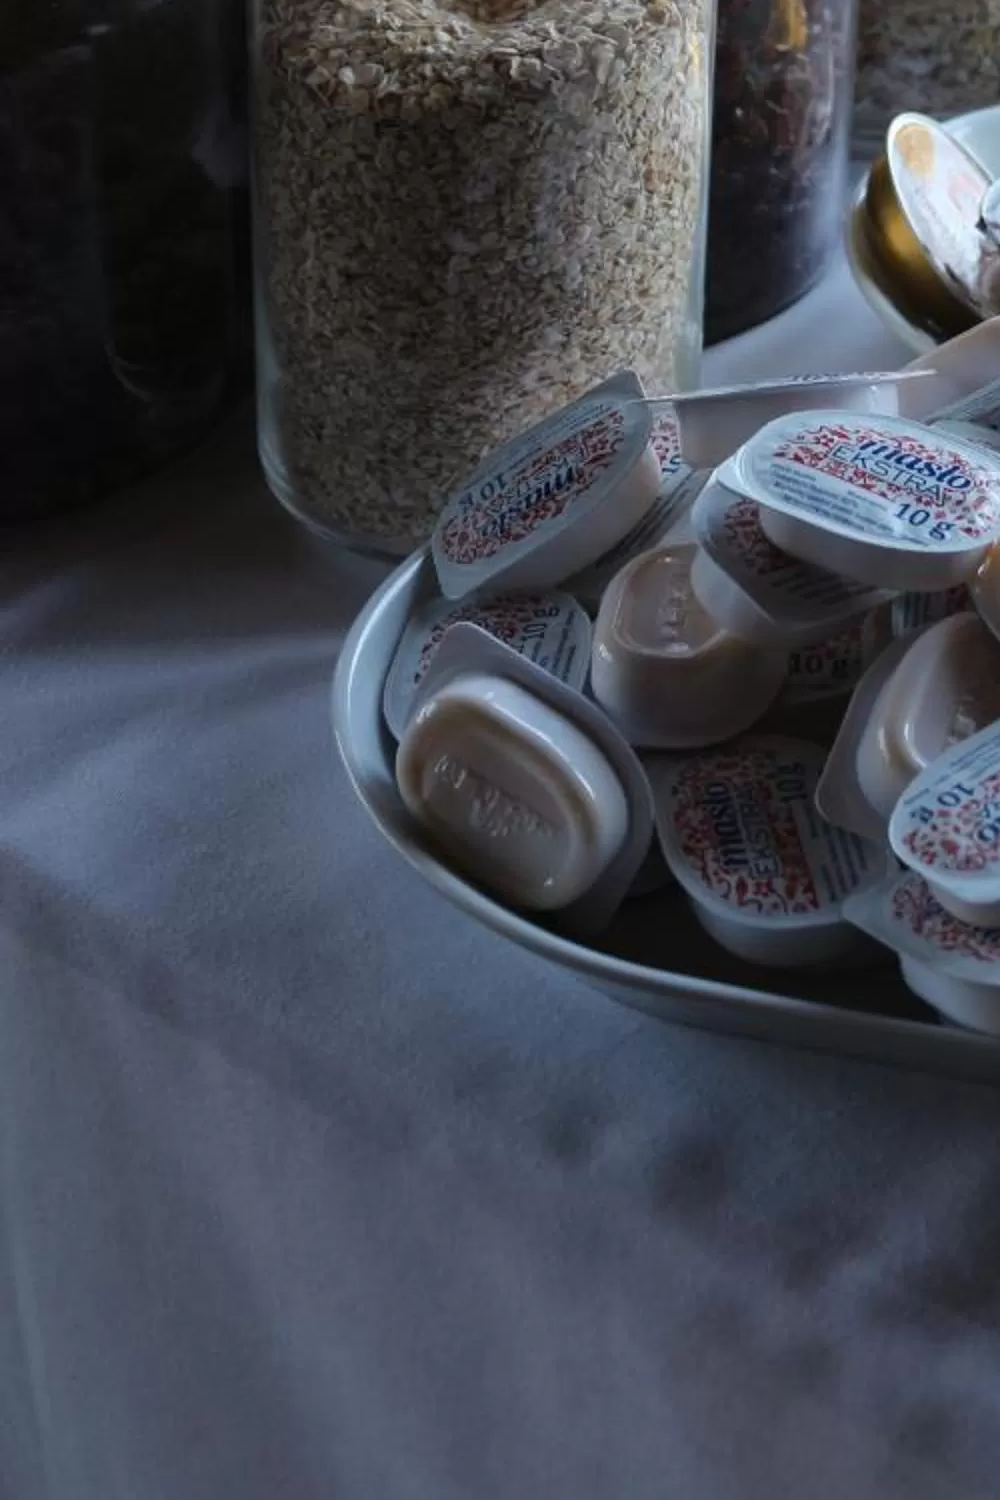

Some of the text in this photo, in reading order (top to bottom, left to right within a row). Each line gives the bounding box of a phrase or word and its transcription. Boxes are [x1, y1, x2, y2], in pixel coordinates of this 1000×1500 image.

[479, 472, 508, 500] 10
[831, 443, 941, 501] EKSTRA
[895, 502, 956, 541] 10 g
[522, 622, 548, 641] 10
[909, 782, 975, 824] 10 g
